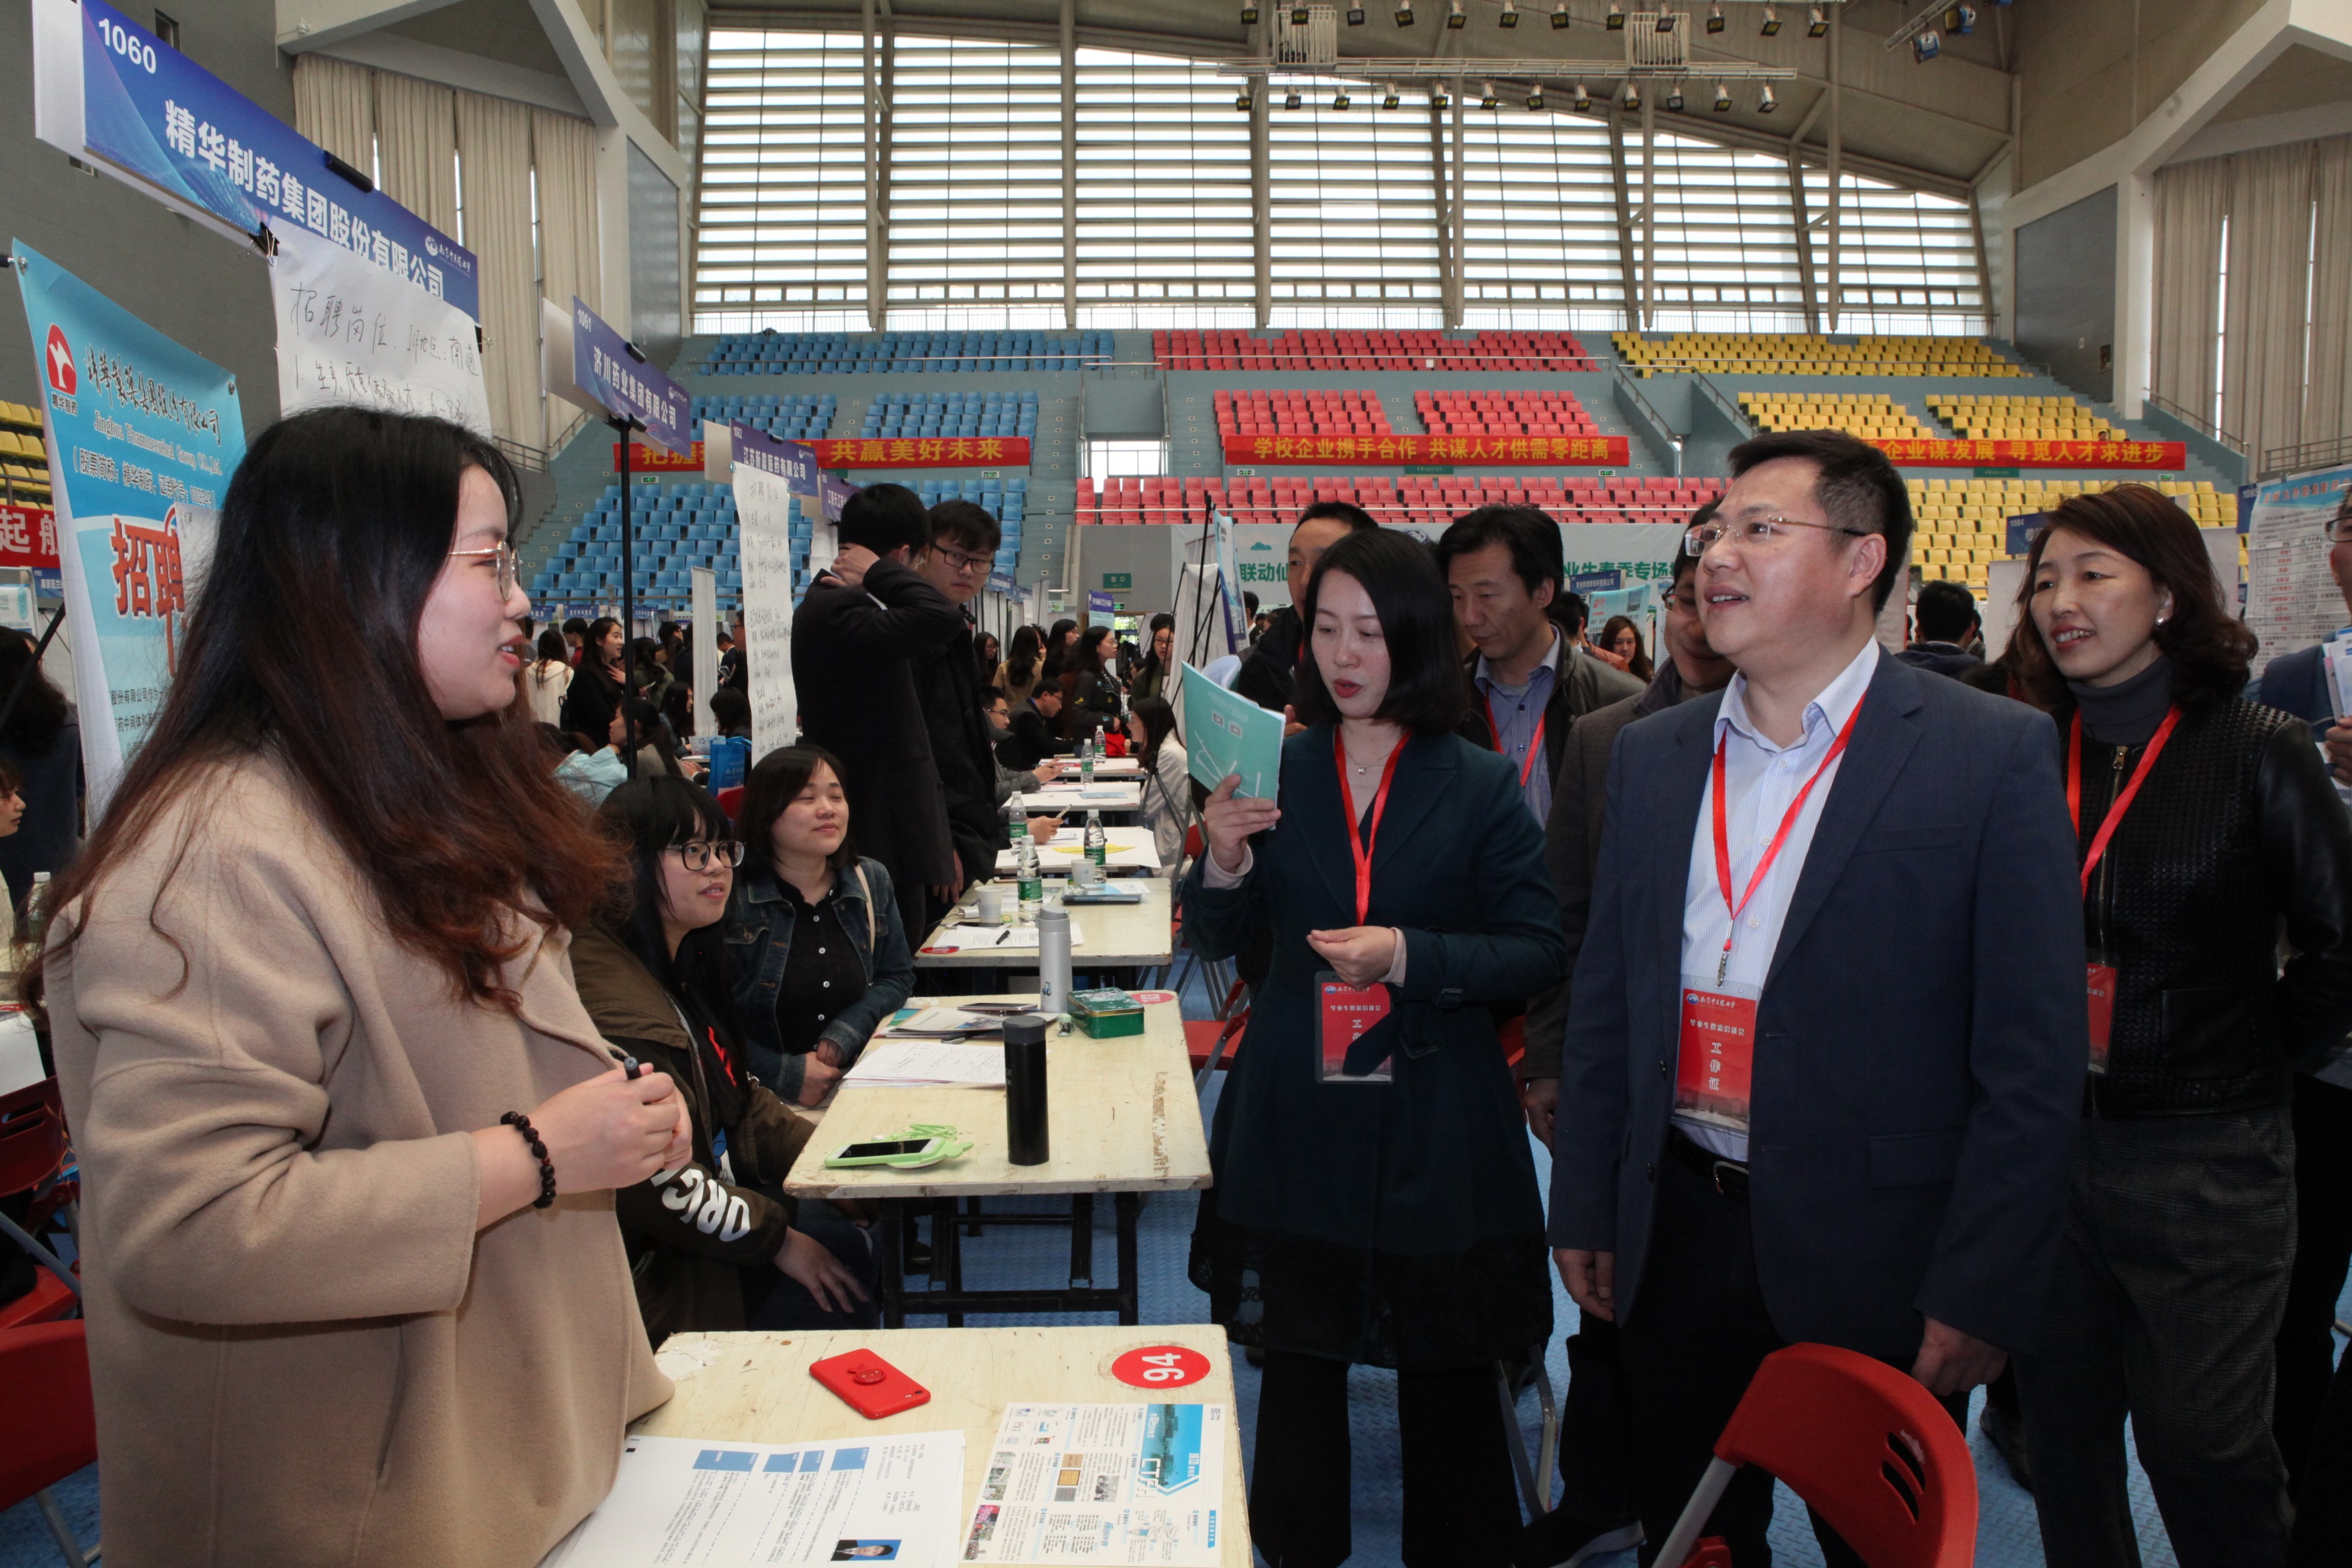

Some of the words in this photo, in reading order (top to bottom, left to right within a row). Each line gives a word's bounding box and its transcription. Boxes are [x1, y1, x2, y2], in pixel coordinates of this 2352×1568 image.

[99, 18, 157, 74] 1060
[165, 100, 444, 301] 精华制药集团股份有限公司
[577, 308, 591, 332] 1061
[593, 345, 676, 430] 济川药业集团有限公司
[52, 391, 78, 416] 精华制药
[94, 410, 125, 440] Jinghua
[830, 439, 1004, 462] 共赢美好未来
[1254, 437, 1417, 460] 学校企业携手合作
[1428, 437, 1609, 460] 共谋人才供需零距离
[2008, 442, 2165, 463] 寻觅人才求进步
[1699, 995, 1737, 1009] 南京中医药大学
[1690, 1018, 1745, 1036] 毕业生供需洽谈会
[1708, 1042, 1722, 1091] 工作证
[1142, 1352, 1185, 1381] 94
